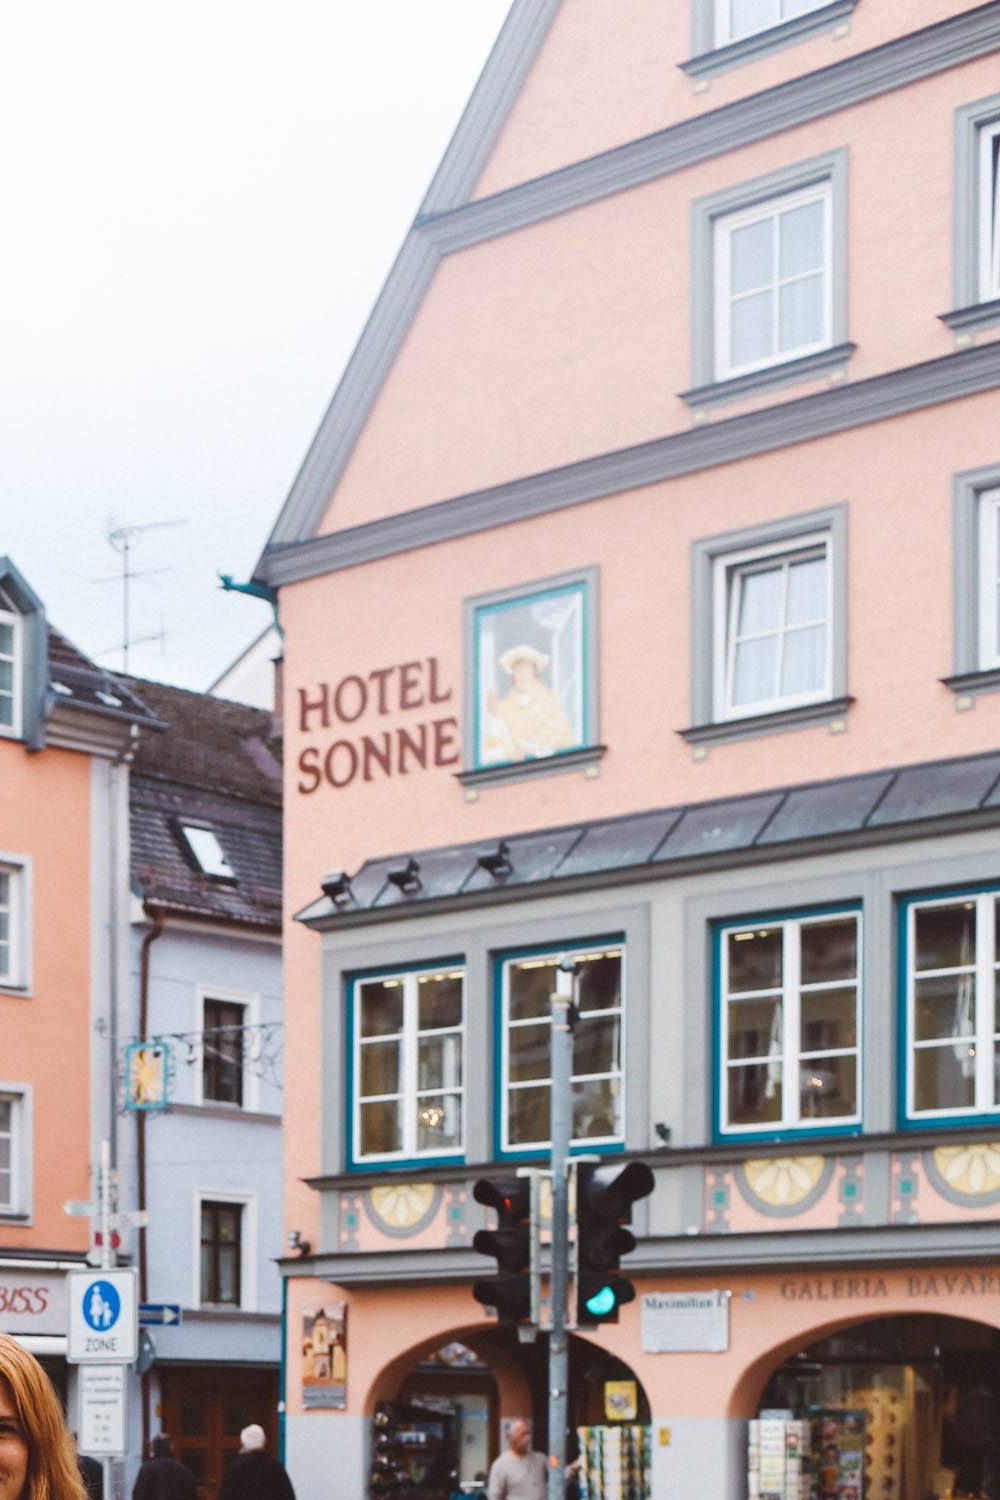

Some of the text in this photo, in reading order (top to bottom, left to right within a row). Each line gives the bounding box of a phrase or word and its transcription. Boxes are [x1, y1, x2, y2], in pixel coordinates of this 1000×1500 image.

[298, 657, 452, 732] HOTEL
[298, 717, 460, 794] SONNE
[780, 1277, 888, 1300] GALERIA
[645, 1296, 713, 1309] Maximilian
[85, 1337, 118, 1352] ZONE
